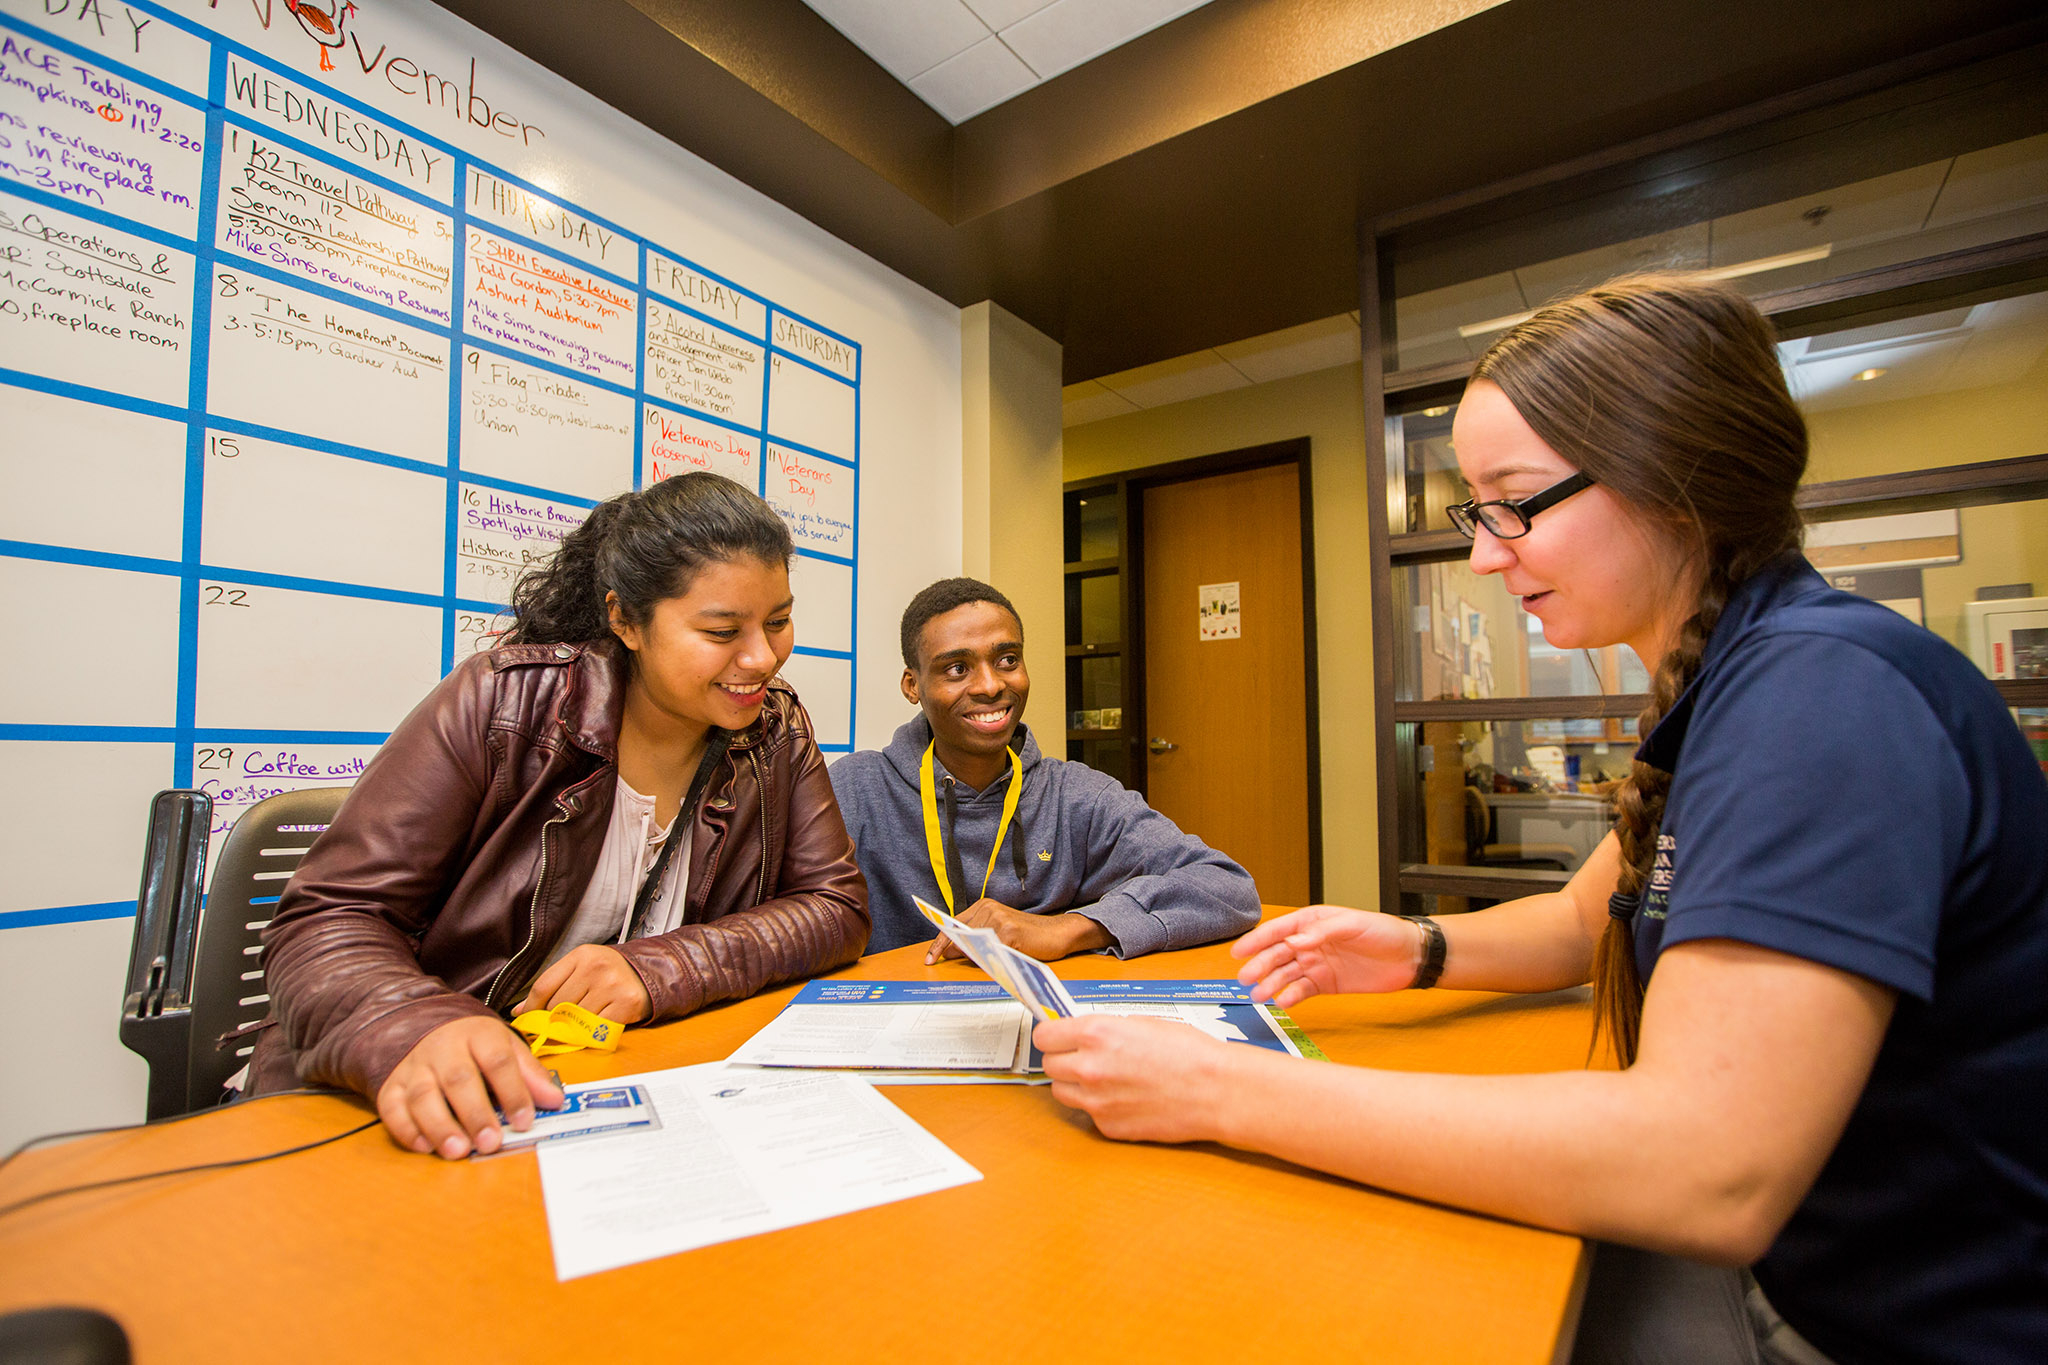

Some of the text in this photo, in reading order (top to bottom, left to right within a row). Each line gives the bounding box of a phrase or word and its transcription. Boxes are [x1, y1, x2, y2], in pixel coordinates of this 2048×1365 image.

[0, 63, 95, 114] umpkins
[2, 37, 162, 126] ACE Tabling
[233, 62, 441, 183] WEDNESDAY
[27, 139, 51, 163] in
[60, 149, 155, 196] fireplace
[38, 125, 152, 184] reviewing
[244, 168, 348, 222] Room 112
[286, 160, 349, 203] Travel
[355, 185, 419, 239] Pathway
[469, 169, 612, 260] THURSDAY
[22, 214, 143, 273] Operations
[151, 253, 171, 275] &
[230, 187, 450, 287] Servant Leadership Pathway
[45, 250, 154, 299] Scottsdale
[226, 228, 450, 322] Mike Sims reviewing Resumes
[470, 233, 486, 256] 2
[487, 239, 526, 267] SHRM
[531, 257, 583, 289] Executive
[470, 256, 506, 281] Todd
[218, 274, 239, 297] 8
[410, 277, 442, 294] room
[654, 258, 741, 320] FRIDAY
[130, 300, 185, 330] Ranch
[468, 298, 634, 374] Mike Sims reviewing resumes
[534, 298, 604, 334] Auditorium
[648, 305, 755, 358] 3 Alcohol Awareness
[130, 328, 179, 351] room
[328, 341, 385, 369] Gardner
[522, 338, 556, 358] room
[647, 345, 682, 366] Officer
[648, 330, 669, 345] and
[728, 361, 748, 374] with
[775, 318, 850, 371] SATURDAY
[467, 352, 480, 374] 9
[490, 363, 528, 403] Flag
[772, 357, 782, 374] 4
[474, 409, 519, 436] Union
[709, 399, 734, 415] room
[211, 436, 240, 458] 15
[645, 408, 750, 466] 10 Veterans Day
[769, 447, 833, 508] 11 Veterans Day
[463, 488, 481, 507] 16
[489, 494, 543, 519] Historic
[467, 509, 535, 541] Spotlight
[799, 512, 815, 530] you
[462, 538, 516, 561] Historic
[205, 585, 250, 608] 22
[459, 615, 486, 633] 23
[197, 747, 233, 769] 29
[243, 751, 320, 774] Coffee
